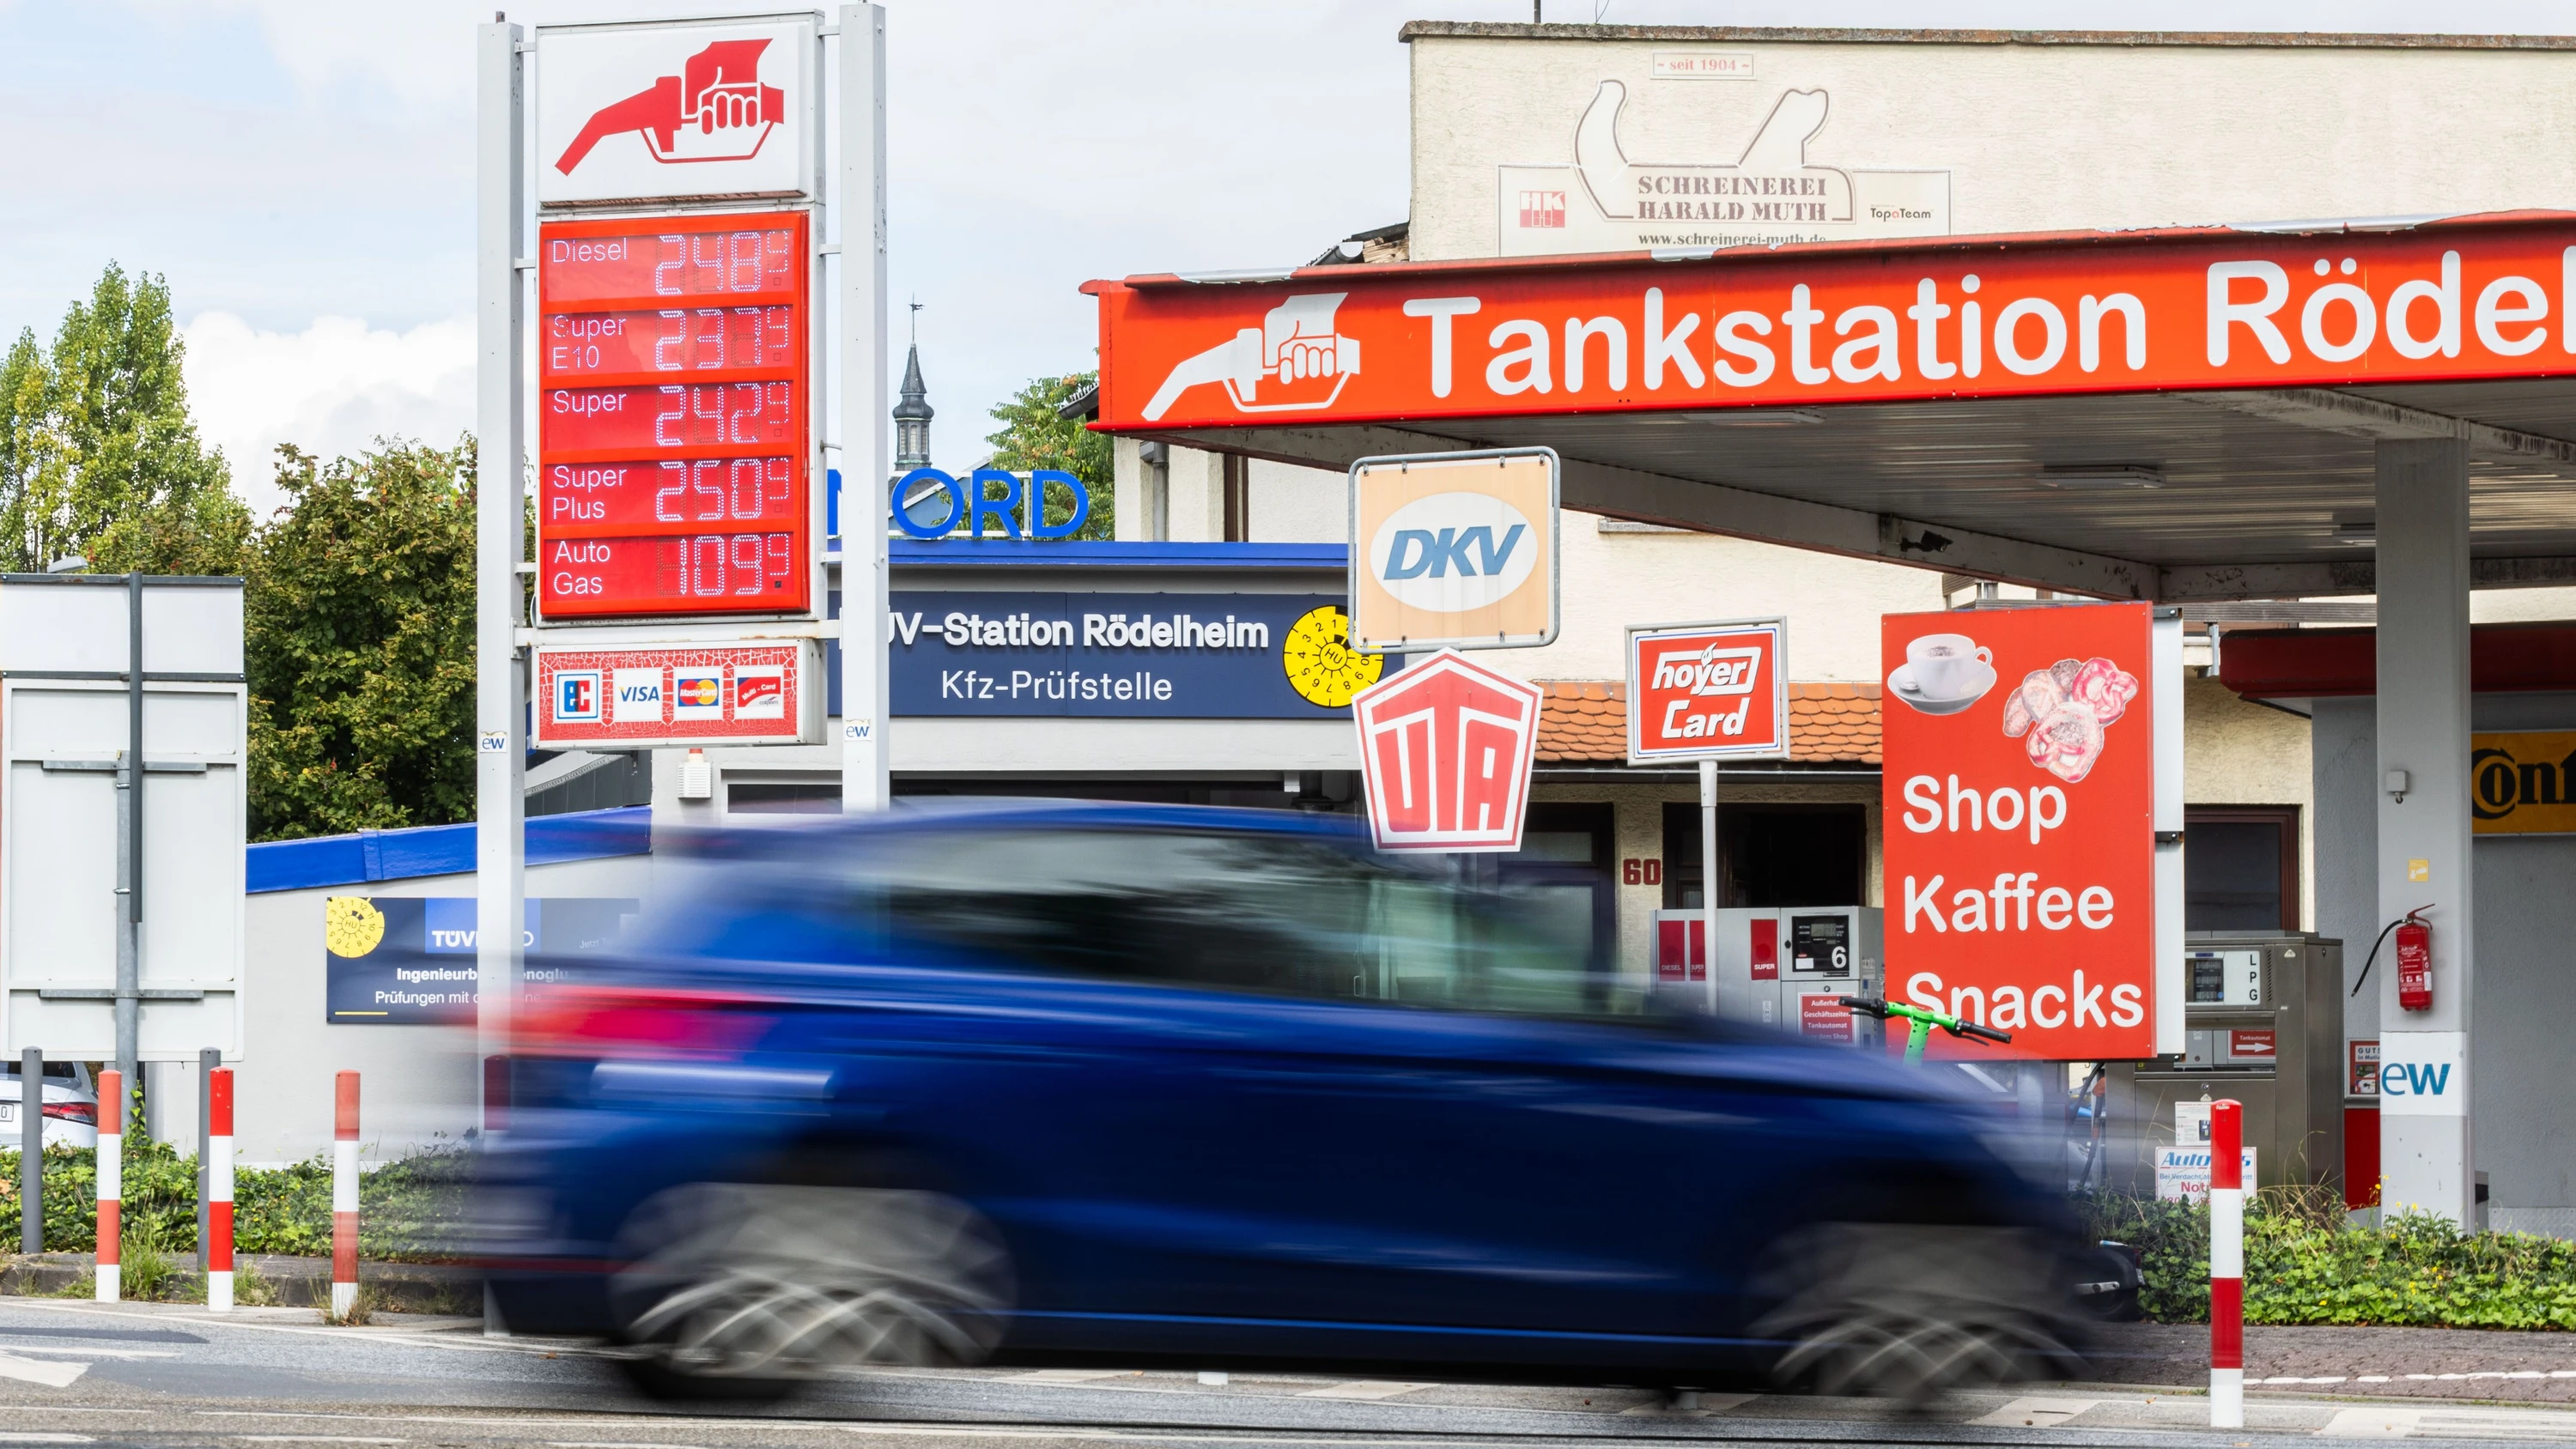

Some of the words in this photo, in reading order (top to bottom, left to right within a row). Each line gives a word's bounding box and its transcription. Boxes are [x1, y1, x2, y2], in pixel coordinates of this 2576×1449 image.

[1669, 58, 1694, 70] seit
[1700, 59, 1736, 70] 1904
[1638, 176, 1826, 196] SCHREINEREI
[1638, 202, 1745, 221] HARALD
[1752, 203, 1826, 221] MUTH
[552, 237, 628, 264] Diesel
[1638, 233, 1826, 245] www.schreinerei-muthde
[552, 314, 628, 342] Super
[1403, 274, 2147, 398] Tankstation
[552, 345, 600, 370] E10
[552, 389, 628, 416] Super
[553, 464, 628, 492] Super
[553, 496, 605, 519] Plus
[554, 540, 611, 563] Auto
[1382, 524, 1526, 580] DKV
[553, 572, 603, 595] Gas
[1083, 613, 1268, 649] Rödelheim
[1324, 648, 1343, 664] HU
[1651, 647, 1755, 696] hoyer
[619, 686, 659, 702] VISA
[741, 687, 757, 700] Multi
[942, 670, 1172, 700] Kfz-Prüfstelle
[846, 724, 870, 738] ew
[1662, 697, 1751, 739] Card
[482, 737, 505, 749] ew
[1371, 669, 1523, 833] UTA
[1903, 774, 2068, 845] Shop
[1623, 858, 1662, 886] 60
[1904, 872, 2114, 934] Kaffee
[345, 920, 357, 929] HU
[1832, 946, 1847, 968] 6
[375, 991, 445, 1006] Prüfungen
[448, 991, 469, 1003] mit
[1905, 969, 2144, 1029] Snacks
[2381, 1063, 2451, 1095] ew
